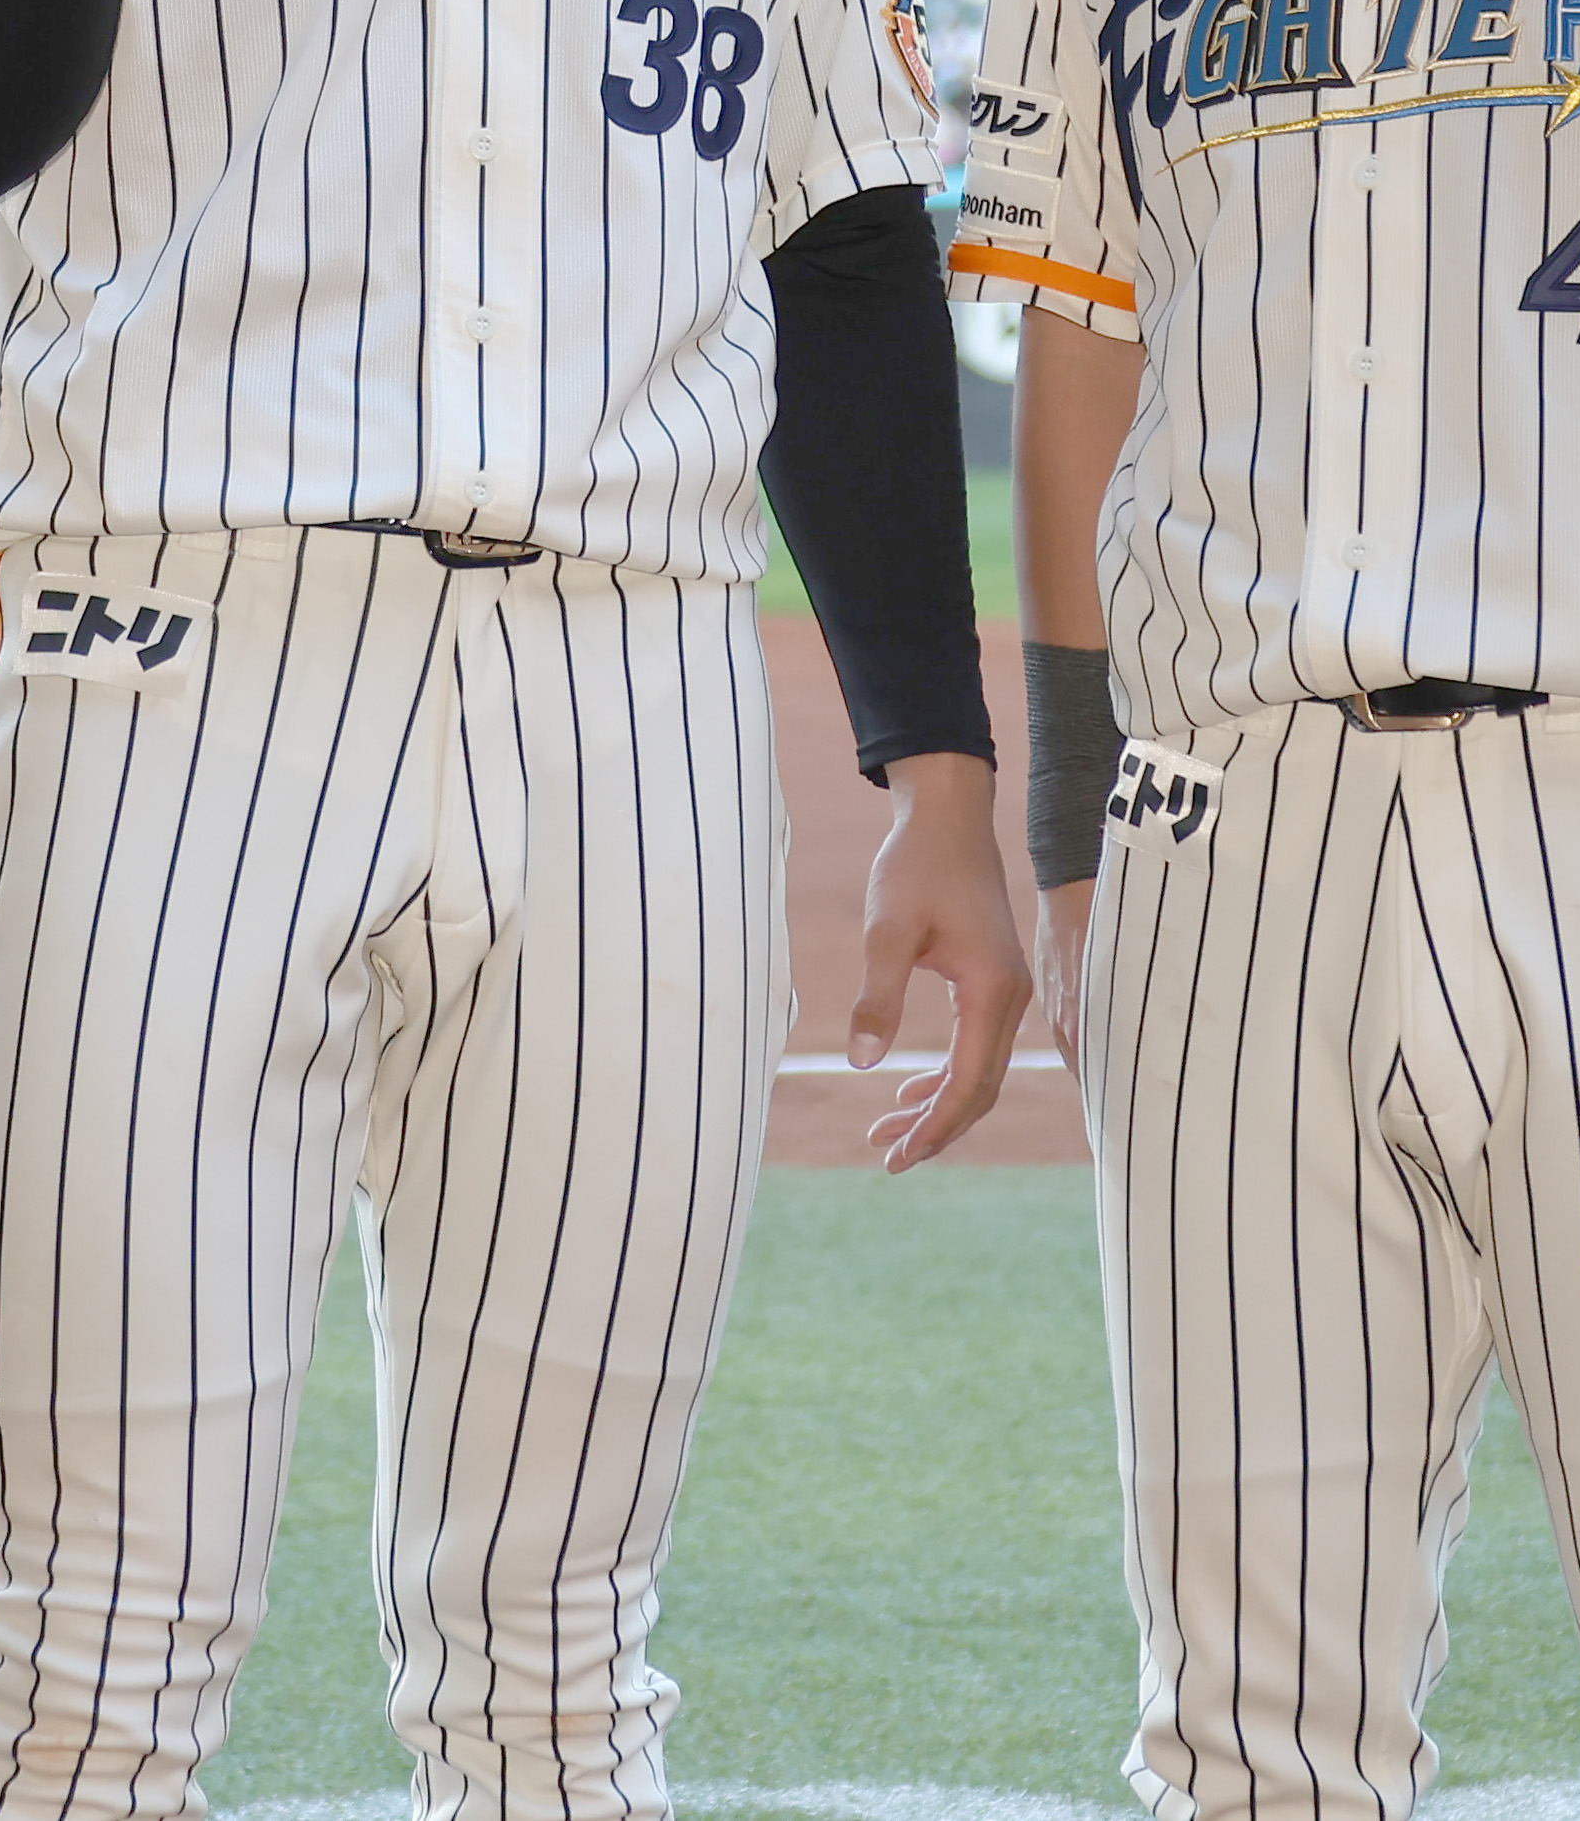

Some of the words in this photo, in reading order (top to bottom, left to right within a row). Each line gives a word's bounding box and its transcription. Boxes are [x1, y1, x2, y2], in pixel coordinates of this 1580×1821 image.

[972, 92, 1052, 137] クレン
[26, 589, 194, 672] ニトリ
[1108, 753, 1209, 846] ニトリ
